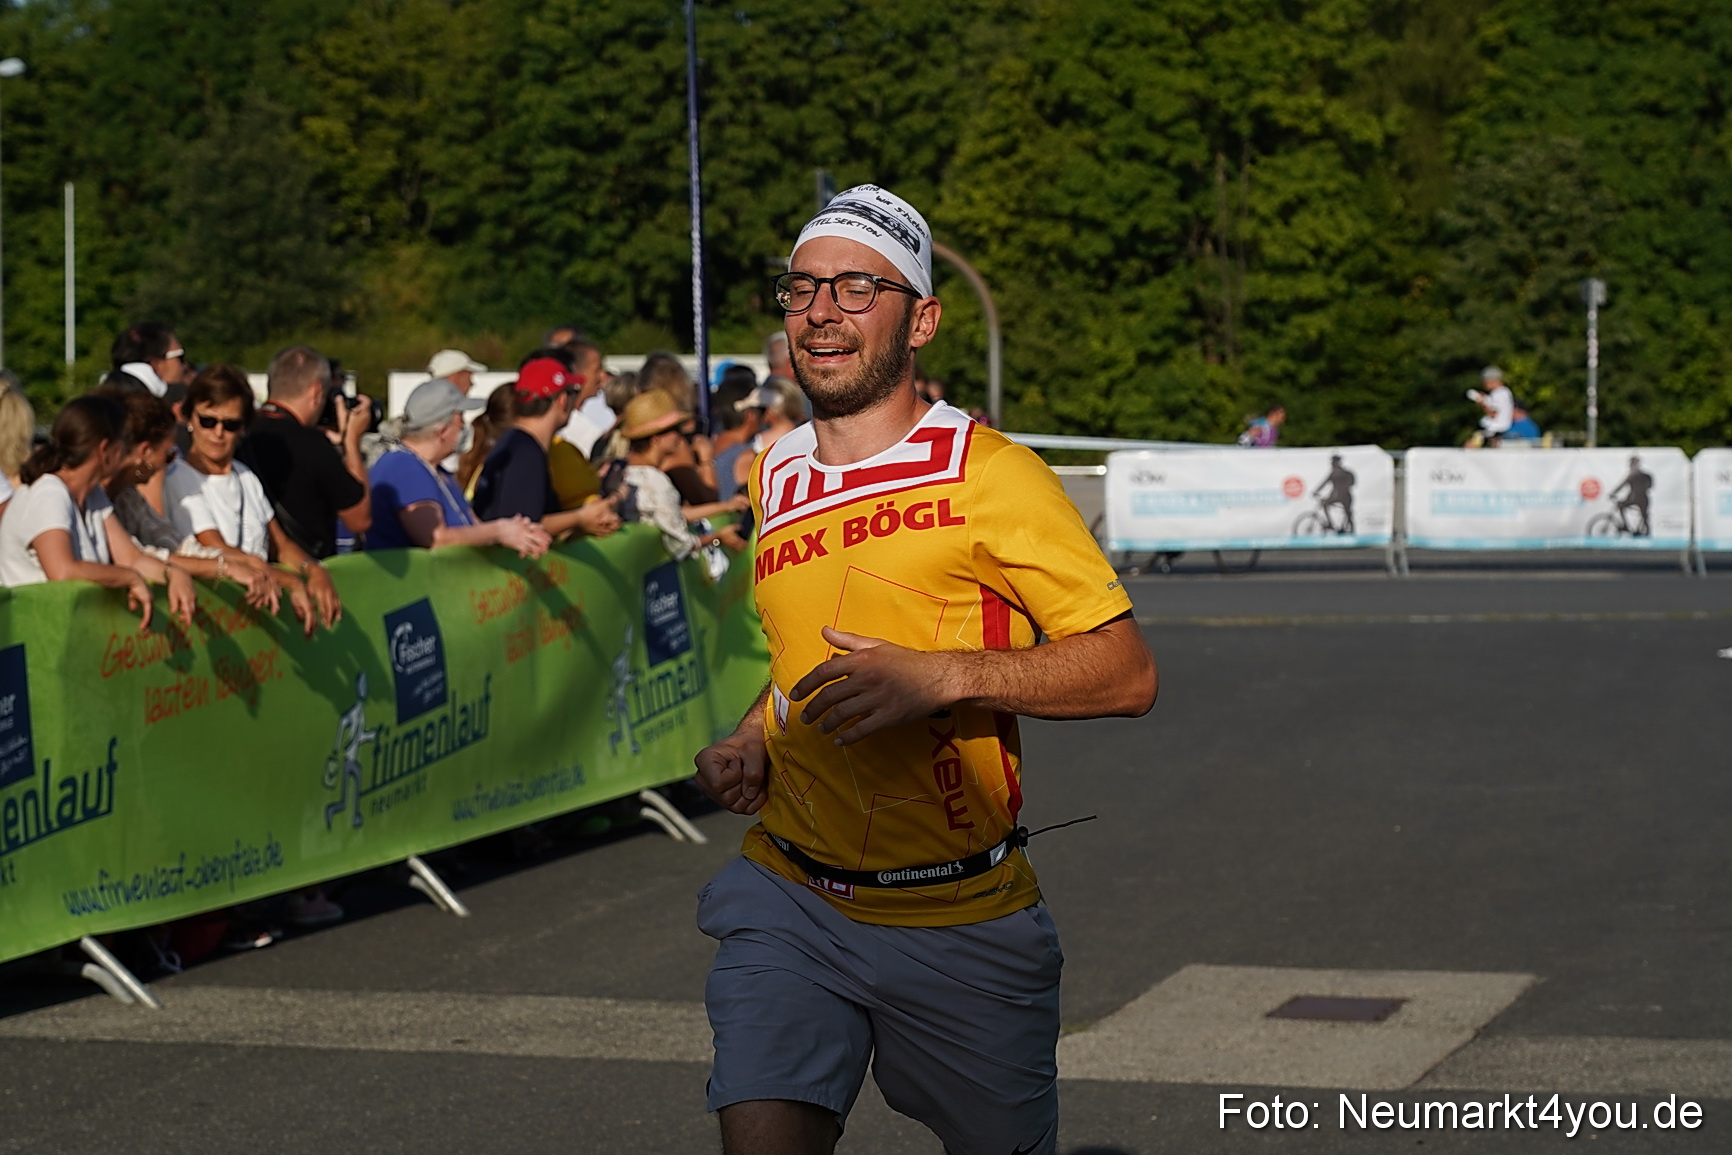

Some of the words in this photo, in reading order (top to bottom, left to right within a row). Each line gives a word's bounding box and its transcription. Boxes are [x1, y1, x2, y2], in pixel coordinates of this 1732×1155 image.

[755, 528, 829, 586] MAX
[843, 497, 966, 548] BÖGL
[371, 674, 492, 790] firmenlauf
[877, 863, 952, 885] Continental
